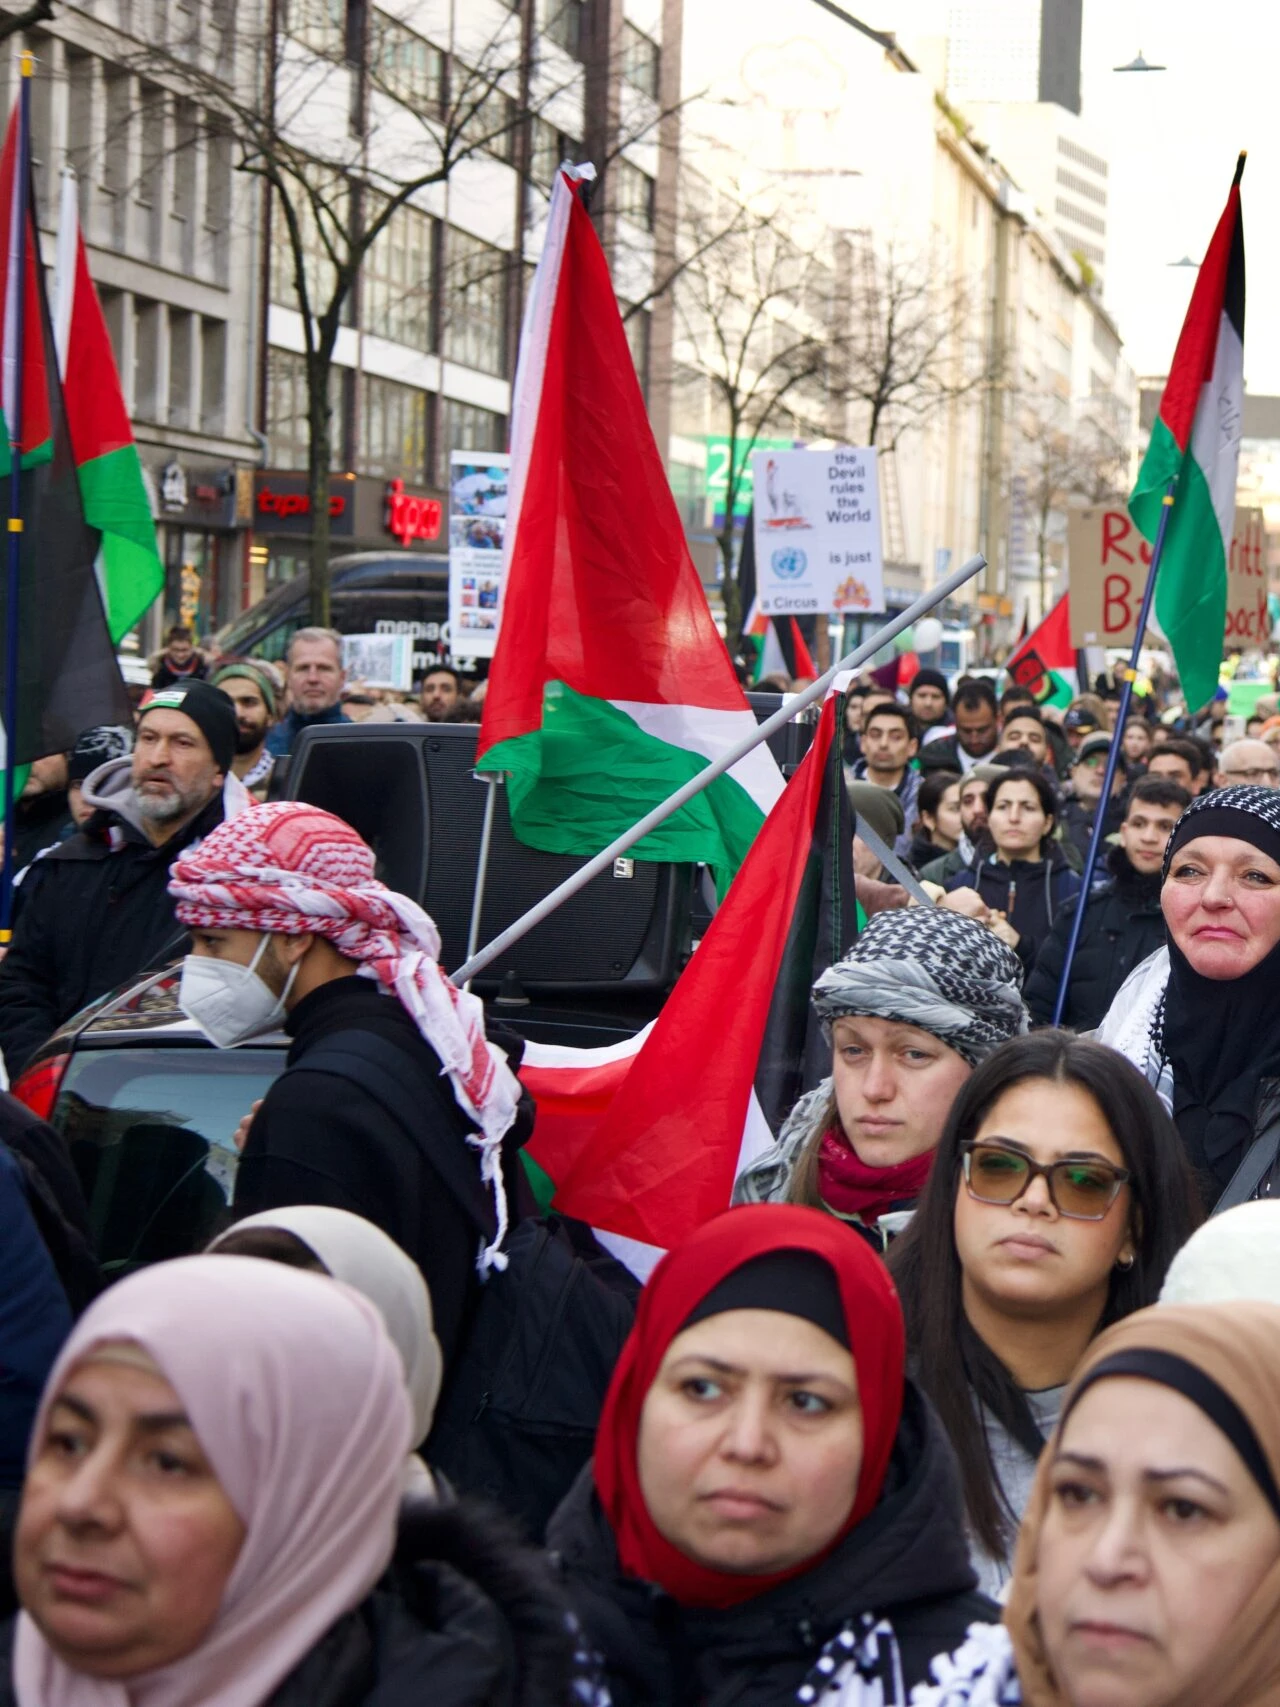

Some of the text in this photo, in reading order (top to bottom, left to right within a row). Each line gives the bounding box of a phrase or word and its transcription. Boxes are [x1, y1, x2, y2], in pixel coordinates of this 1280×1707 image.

[834, 453, 857, 465] the
[828, 466, 865, 480] Devil
[830, 482, 864, 494] rules
[257, 486, 346, 520] tipio
[836, 497, 859, 508] the
[826, 510, 871, 523] World
[829, 551, 872, 566] is just
[774, 597, 818, 609] Circus
